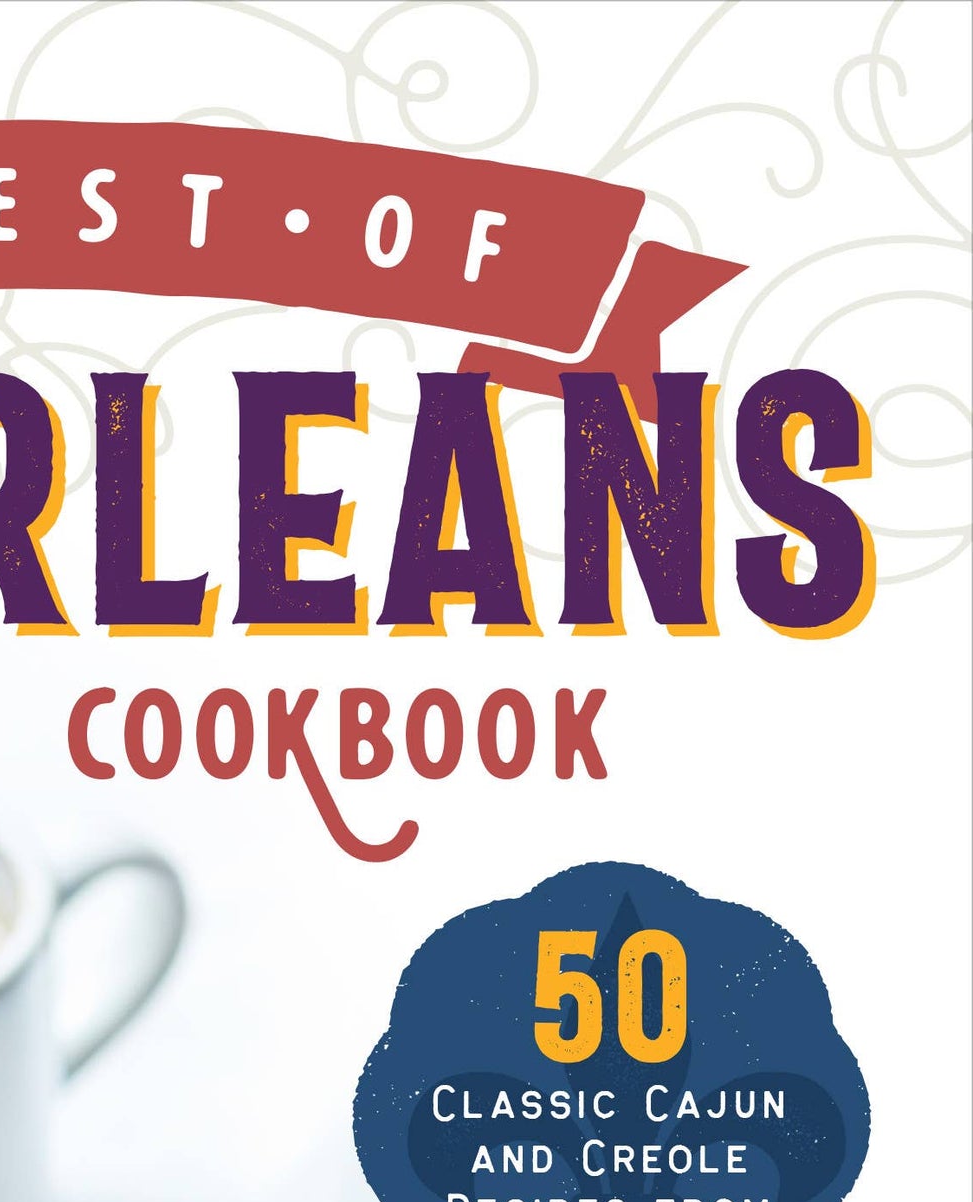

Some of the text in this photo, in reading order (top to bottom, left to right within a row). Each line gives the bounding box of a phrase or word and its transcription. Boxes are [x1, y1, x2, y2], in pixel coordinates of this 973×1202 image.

[365, 195, 506, 282] OF
[68, 687, 607, 862] COOKBOOK
[535, 930, 686, 1062] 50
